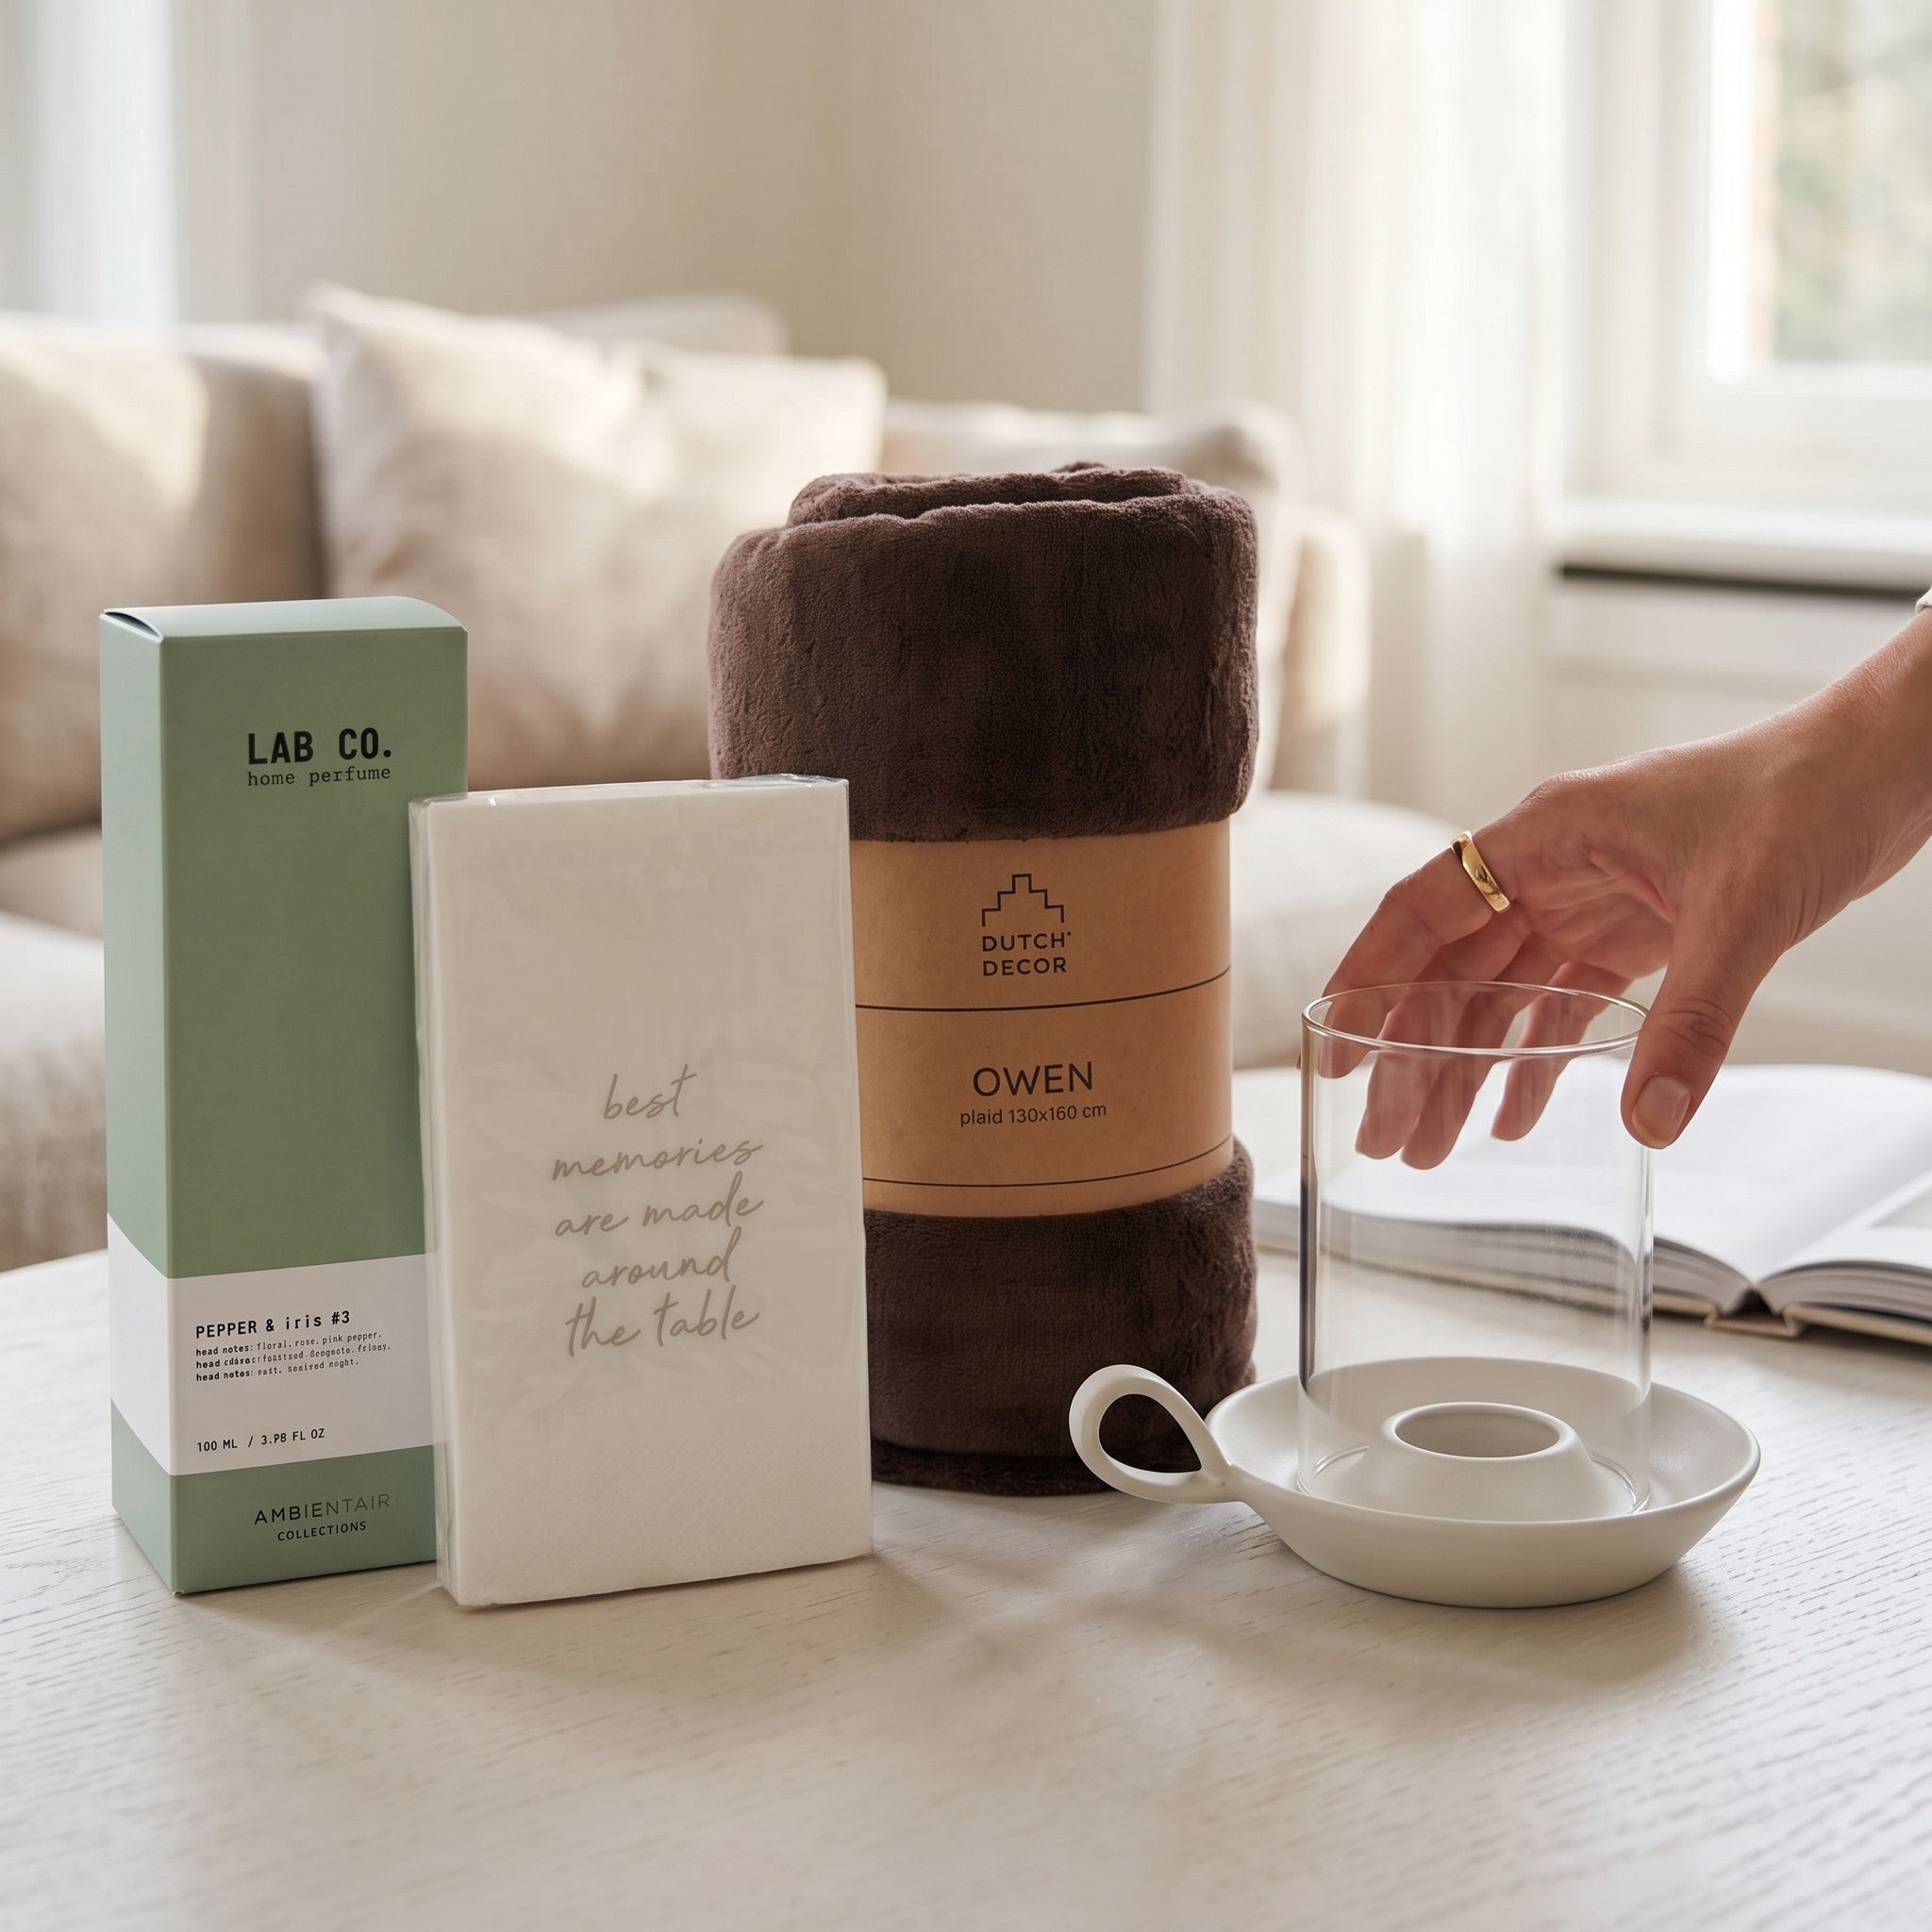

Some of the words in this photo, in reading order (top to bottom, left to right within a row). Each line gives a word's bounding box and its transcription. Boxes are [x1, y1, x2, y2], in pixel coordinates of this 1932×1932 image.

[248, 731, 314, 765] LAB
[339, 727, 391, 760] CO.
[247, 771, 295, 787] home
[308, 766, 391, 787] perfume
[982, 957, 1067, 976] DECOR
[604, 1063, 698, 1120] best
[973, 1061, 1093, 1097] OWEN
[960, 1108, 1003, 1127] plaid
[1008, 1105, 1077, 1124] 130x160
[1082, 1104, 1107, 1119] cm
[551, 1138, 764, 1181] memories
[555, 1213, 629, 1237] are
[642, 1170, 764, 1227] made
[581, 1225, 742, 1290] around
[195, 1321, 258, 1339] PEPPER
[265, 1319, 275, 1331] &
[285, 1314, 322, 1329] iris
[331, 1310, 350, 1325] #3
[565, 1295, 641, 1357] the
[653, 1285, 760, 1347] table
[195, 1346, 219, 1356] head
[223, 1344, 253, 1354] notes:
[323, 1335, 342, 1345] pink
[195, 1359, 220, 1369] head
[195, 1372, 220, 1381] head
[197, 1441, 217, 1452] 100
[223, 1439, 238, 1449] ML
[248, 1436, 253, 1447] /
[292, 1431, 306, 1441] FL
[310, 1428, 325, 1439] OZ
[254, 1493, 391, 1525] AMBIENTAIR
[277, 1521, 367, 1541] COLLECTIONS
